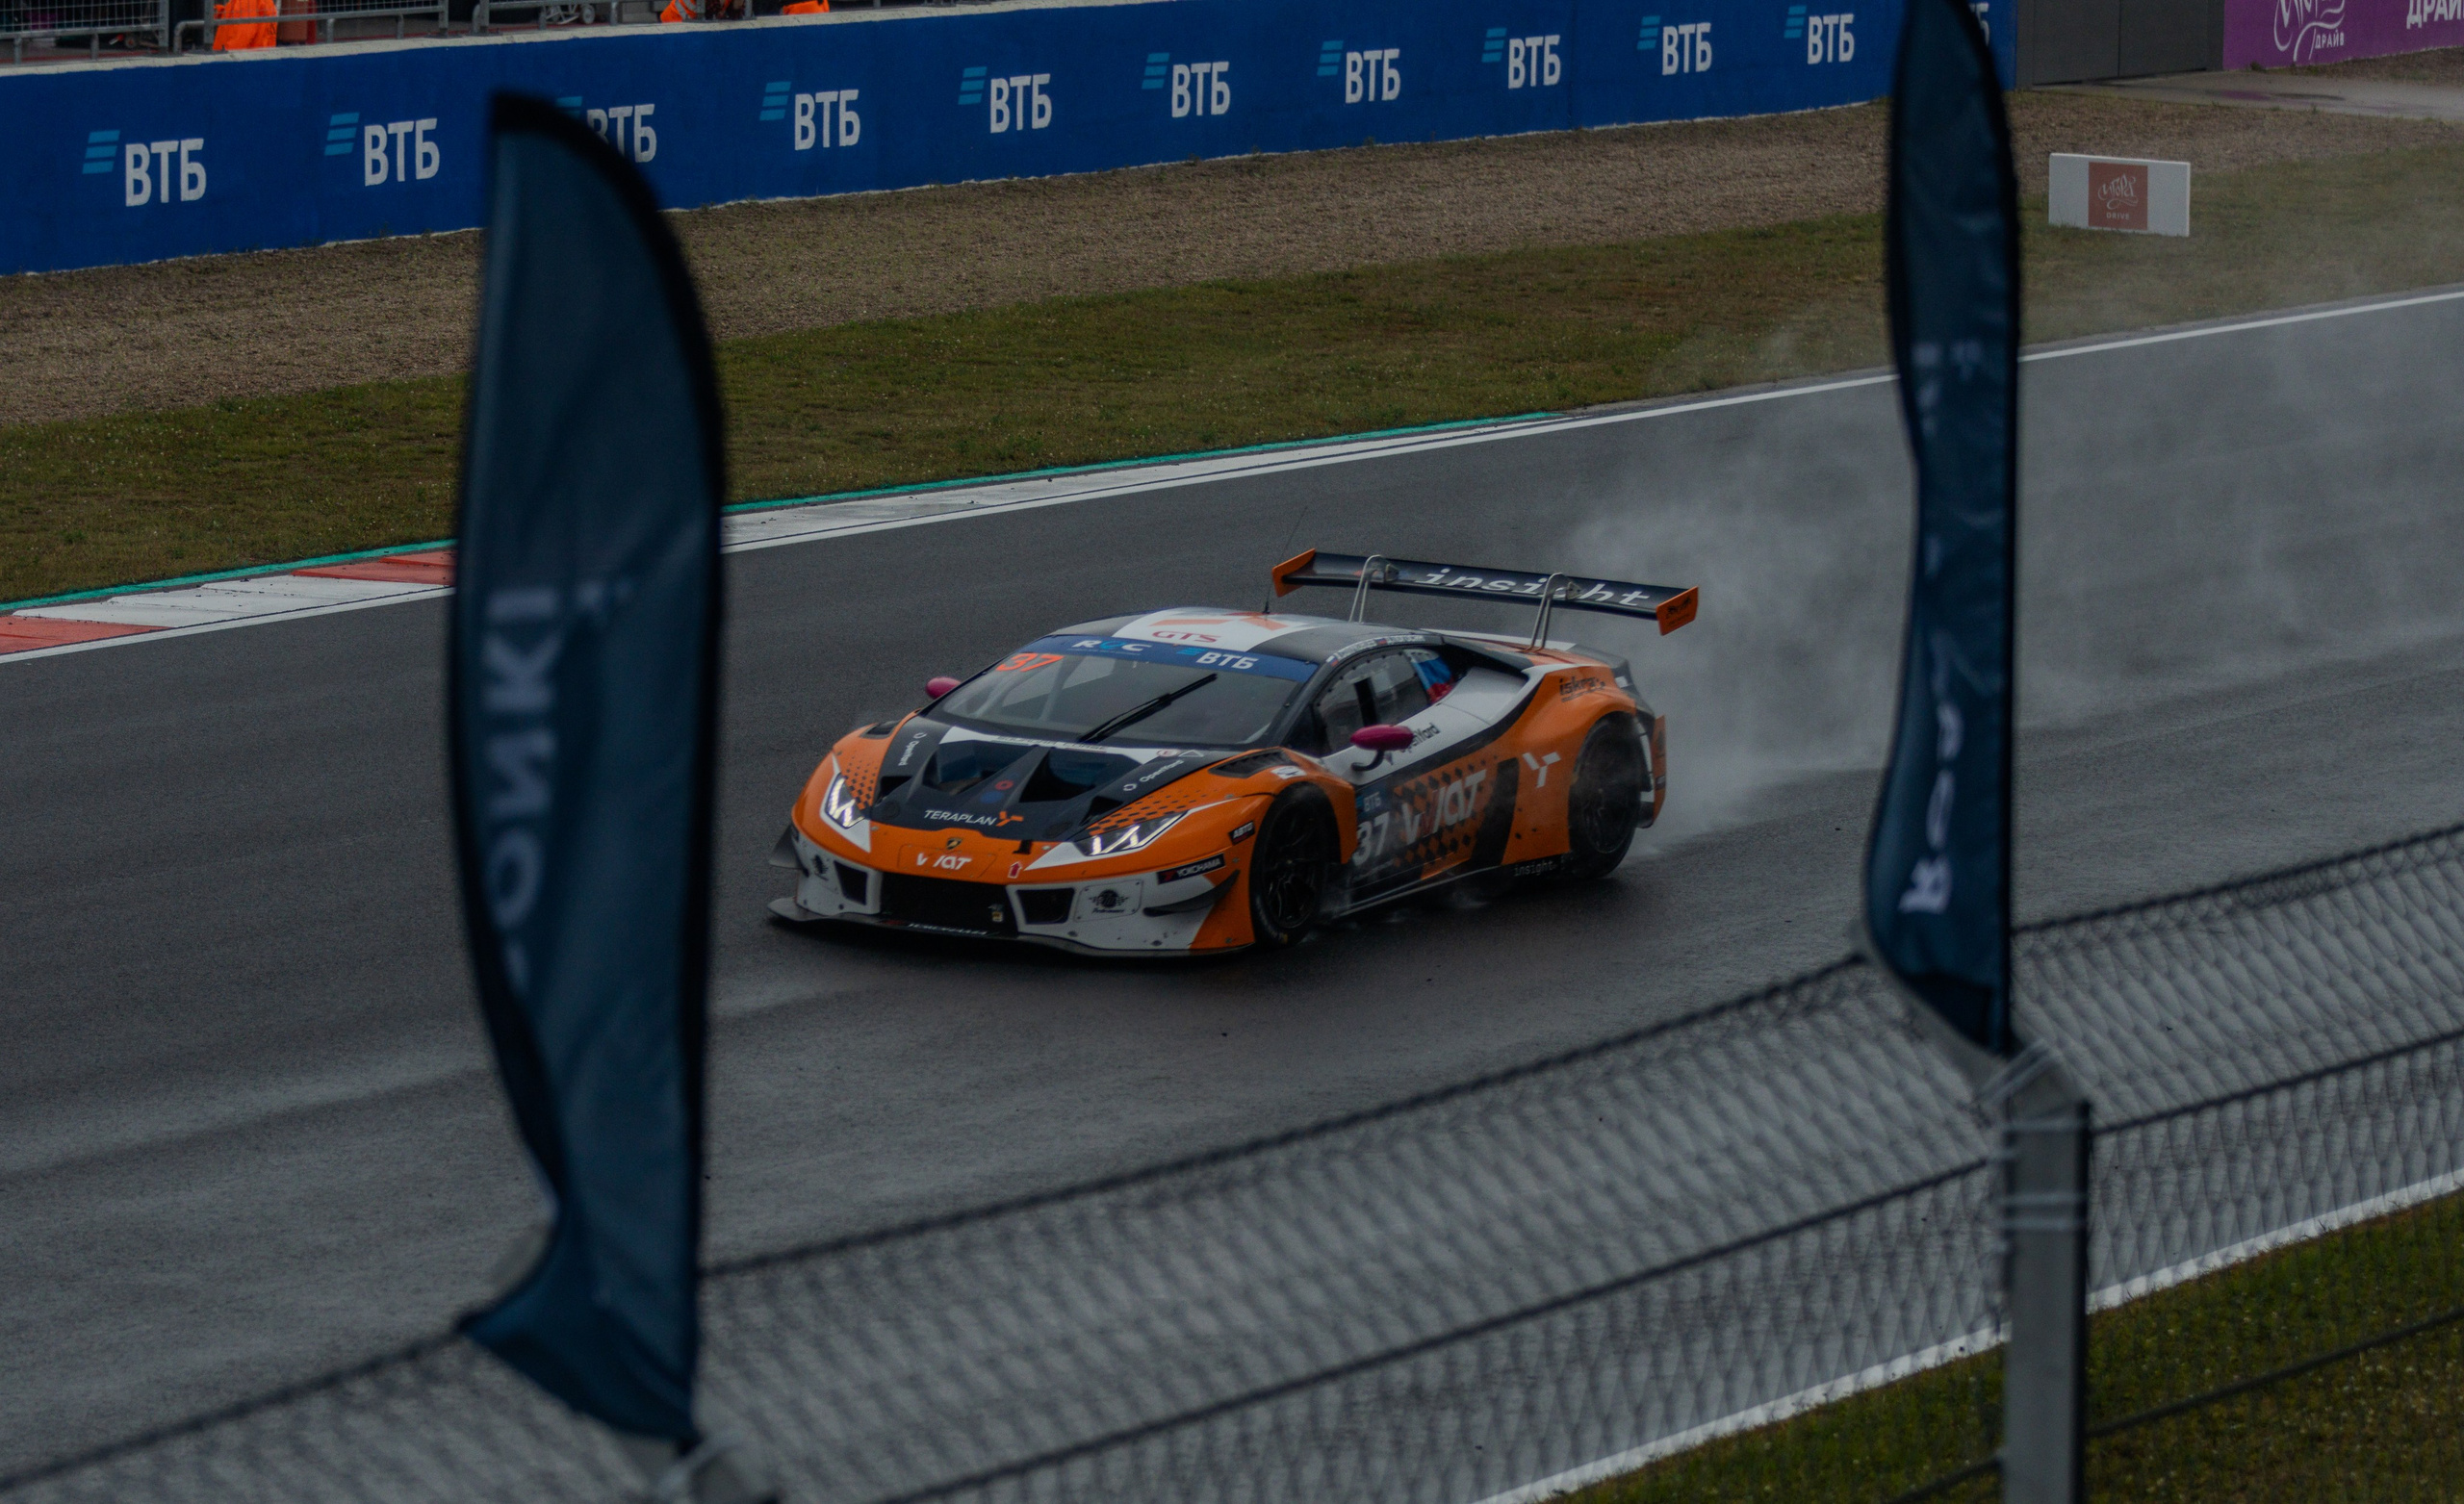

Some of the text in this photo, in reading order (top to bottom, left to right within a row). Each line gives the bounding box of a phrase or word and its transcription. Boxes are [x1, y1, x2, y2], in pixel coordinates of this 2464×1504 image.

[1508, 35, 1561, 89] ВТБ
[1662, 22, 1712, 75] ВТБ
[1808, 13, 1856, 64] ВТБ
[2314, 29, 2346, 50] ДРАЙВ
[1171, 61, 1230, 117] ВТБ
[1346, 48, 1400, 103] ВТБ
[794, 89, 860, 151] ВТБ
[990, 73, 1052, 134] ВТБ
[125, 138, 206, 207] ВТБ
[365, 118, 440, 187] ВТБ
[2106, 212, 2130, 220] DRIVE
[995, 652, 1065, 673] 37
[1152, 630, 1221, 643] GTS
[1195, 651, 1259, 670] ВТБ
[923, 809, 998, 826] TERAPLAN
[1352, 811, 1390, 867] 37
